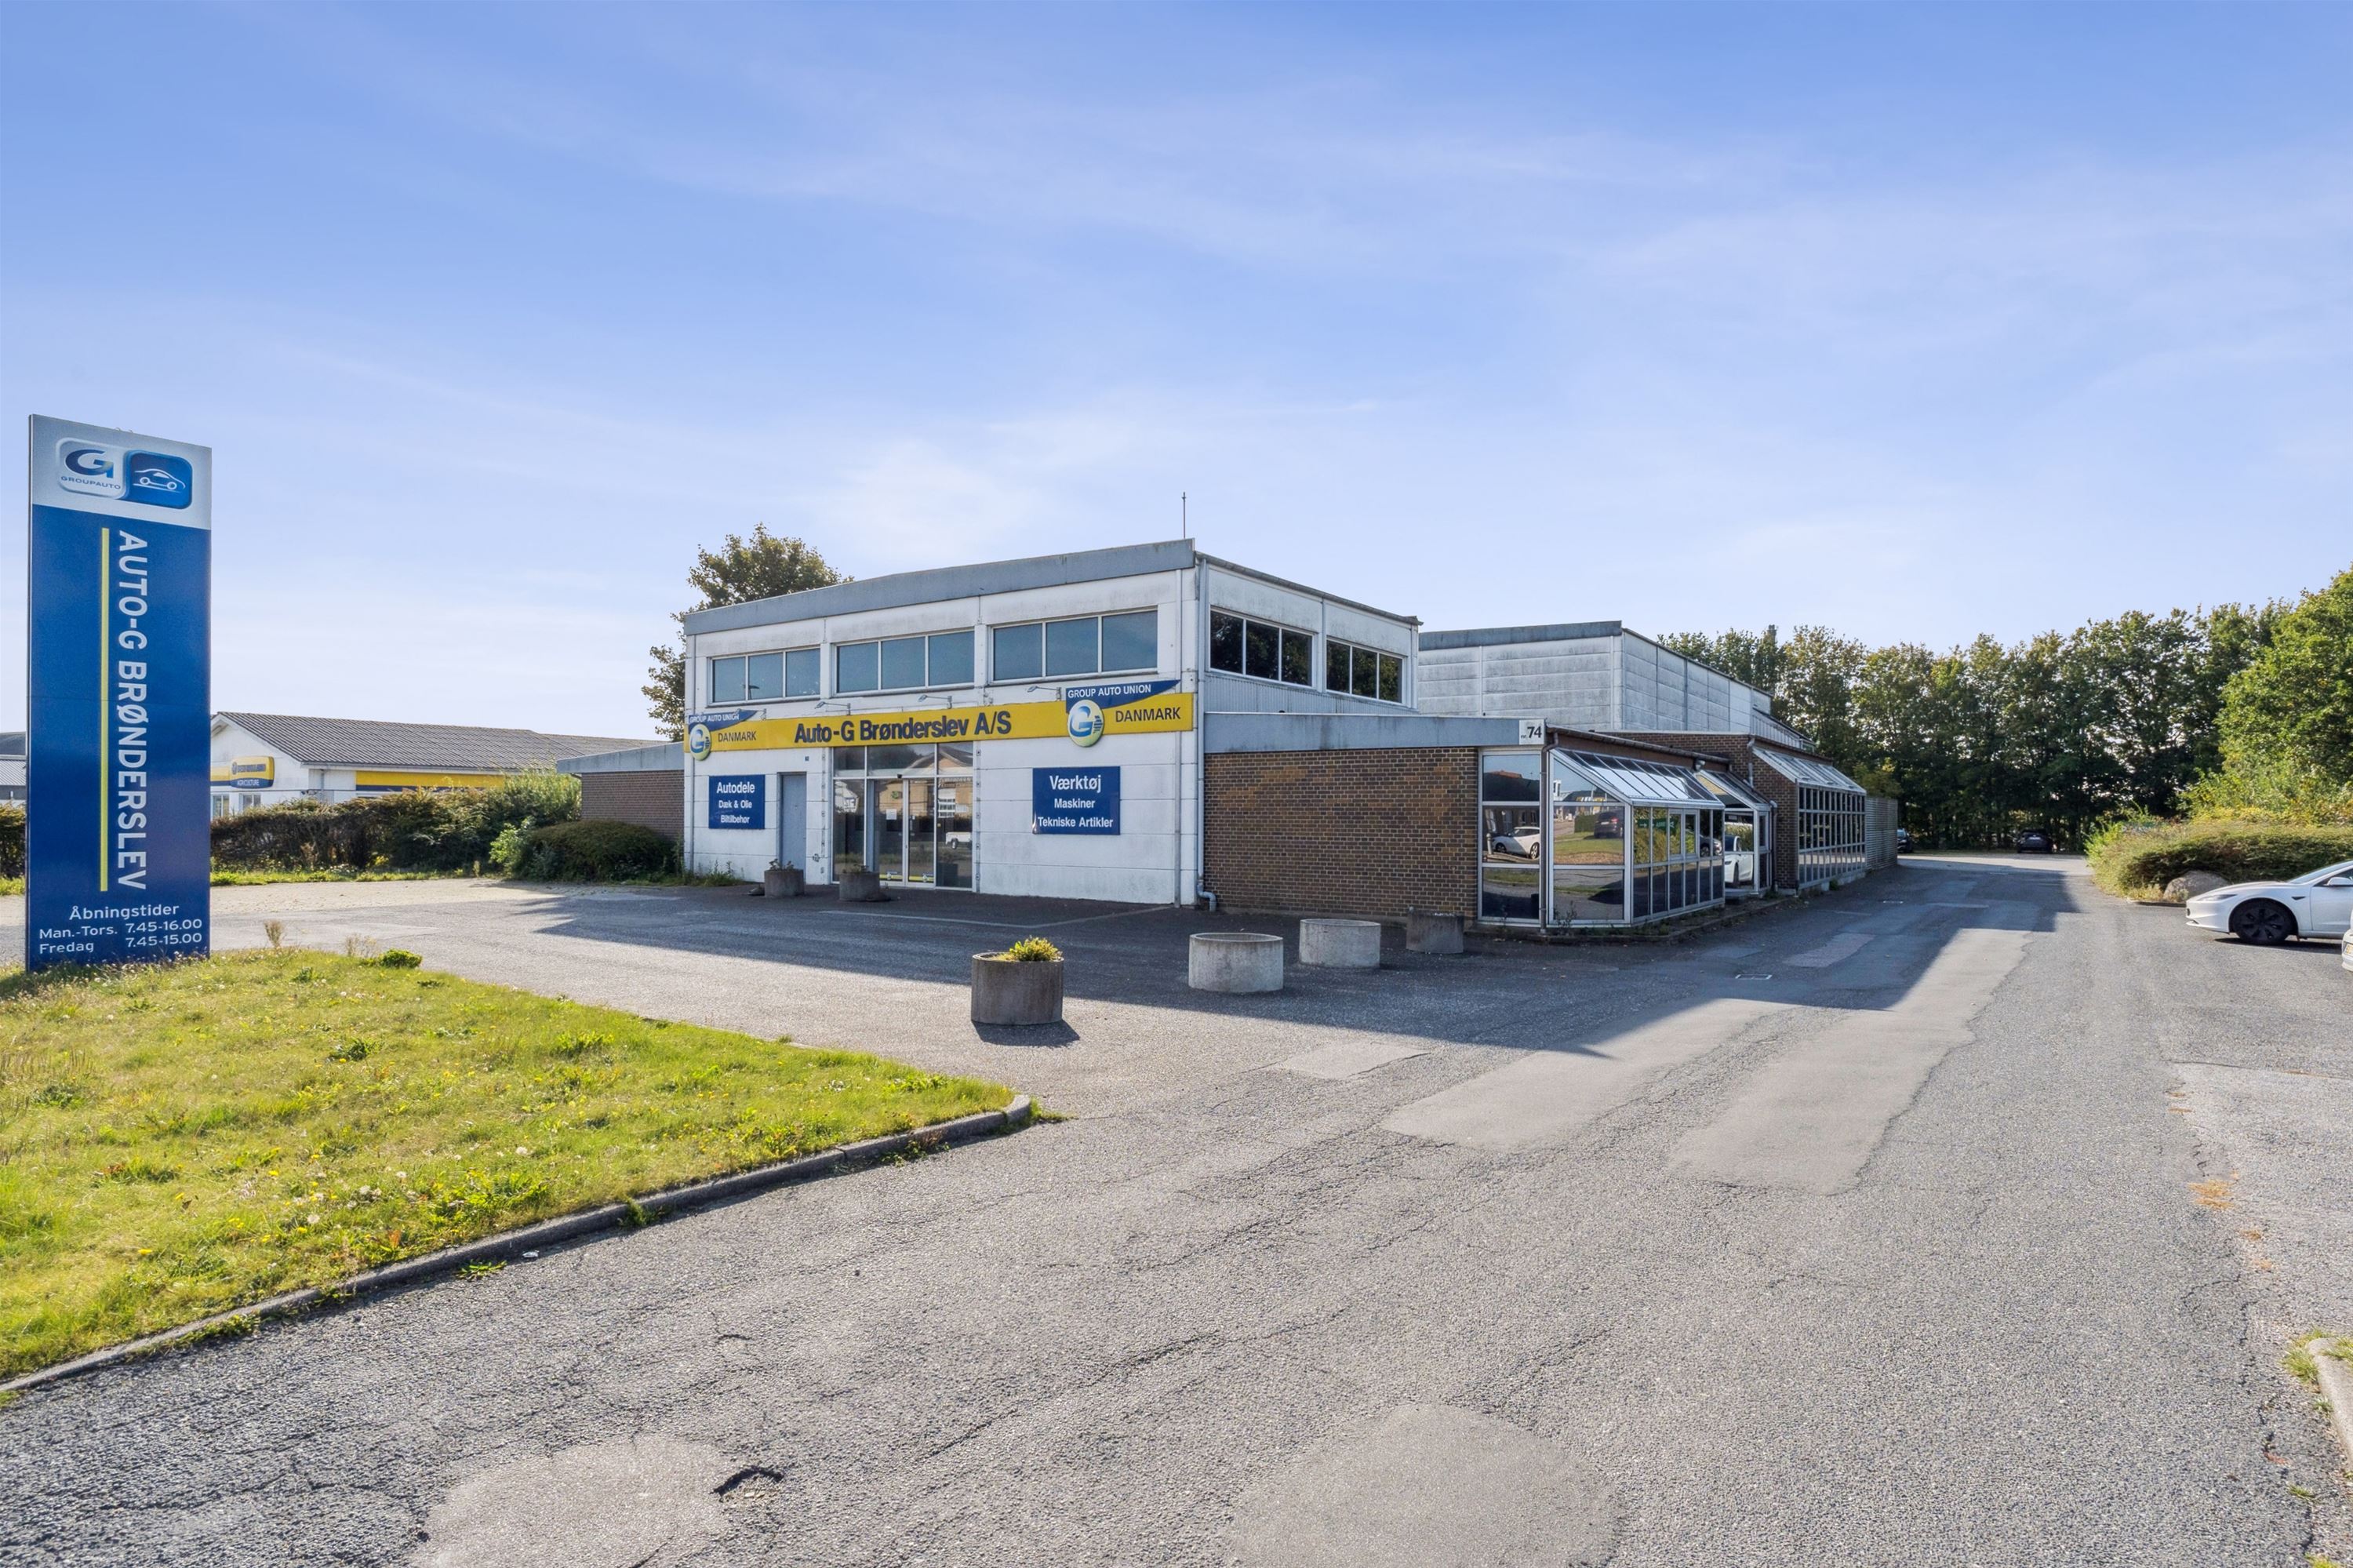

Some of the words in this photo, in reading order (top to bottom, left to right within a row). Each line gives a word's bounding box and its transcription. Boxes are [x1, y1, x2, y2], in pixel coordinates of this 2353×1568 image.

[60, 475, 121, 490] GROUPAUTO
[118, 529, 147, 649] AUTO-G
[1067, 689, 1096, 698] GROUP
[1098, 686, 1122, 697] AUTO
[1123, 684, 1151, 694] UNION
[1115, 707, 1180, 722] DANMARK
[795, 720, 854, 743] Auto-G
[860, 715, 969, 740] Brønderslev
[974, 711, 1012, 735] A/S
[1527, 726, 1542, 739] 74
[718, 731, 756, 742] DANMARK
[117, 660, 149, 890] BRØNDERSLEV
[716, 781, 755, 793] Autodele
[1049, 774, 1101, 793] Værktøj
[718, 800, 733, 809] Dæk
[733, 800, 739, 809] &
[740, 800, 752, 809] Olie
[1054, 798, 1096, 809] Maskiner
[1038, 817, 1076, 827] Tekniske
[1078, 817, 1114, 828] Artikler
[69, 904, 180, 920] Åbningstider
[39, 926, 118, 940] Man.-Tors.
[125, 919, 202, 933] 7.45-16.00
[39, 942, 94, 955] Fredag
[125, 933, 202, 948] 7.45-15.00
